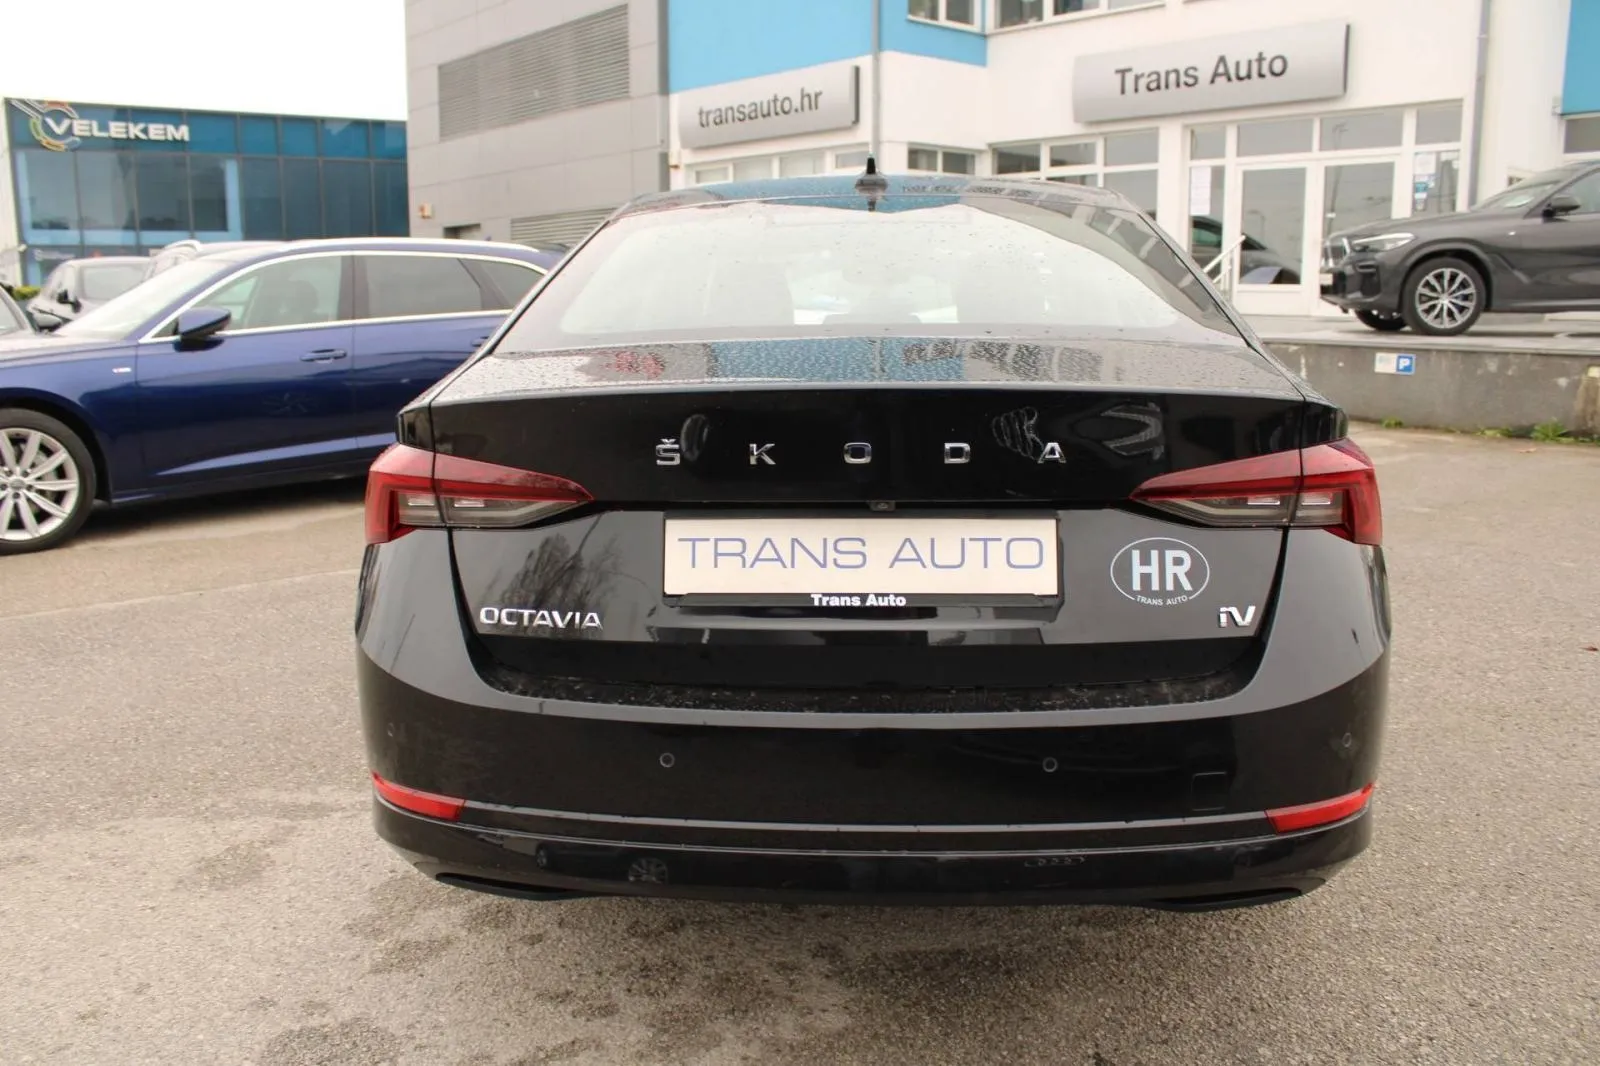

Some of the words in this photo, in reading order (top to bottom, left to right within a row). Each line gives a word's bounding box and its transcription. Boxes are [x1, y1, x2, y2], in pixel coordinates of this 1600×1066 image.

[1115, 66, 1199, 95] Trans
[1209, 52, 1288, 84] Auto
[698, 87, 823, 128] transauto.hr
[44, 116, 190, 142] VELEKEM
[678, 537, 866, 569] TRANS
[889, 537, 1044, 569] AUTO
[1131, 549, 1193, 591] HR
[811, 594, 861, 607] Trans
[867, 594, 907, 607] Auto
[1136, 594, 1163, 606] TRANS
[1166, 594, 1189, 606] AUTO
[479, 607, 604, 630] OCTAVIA
